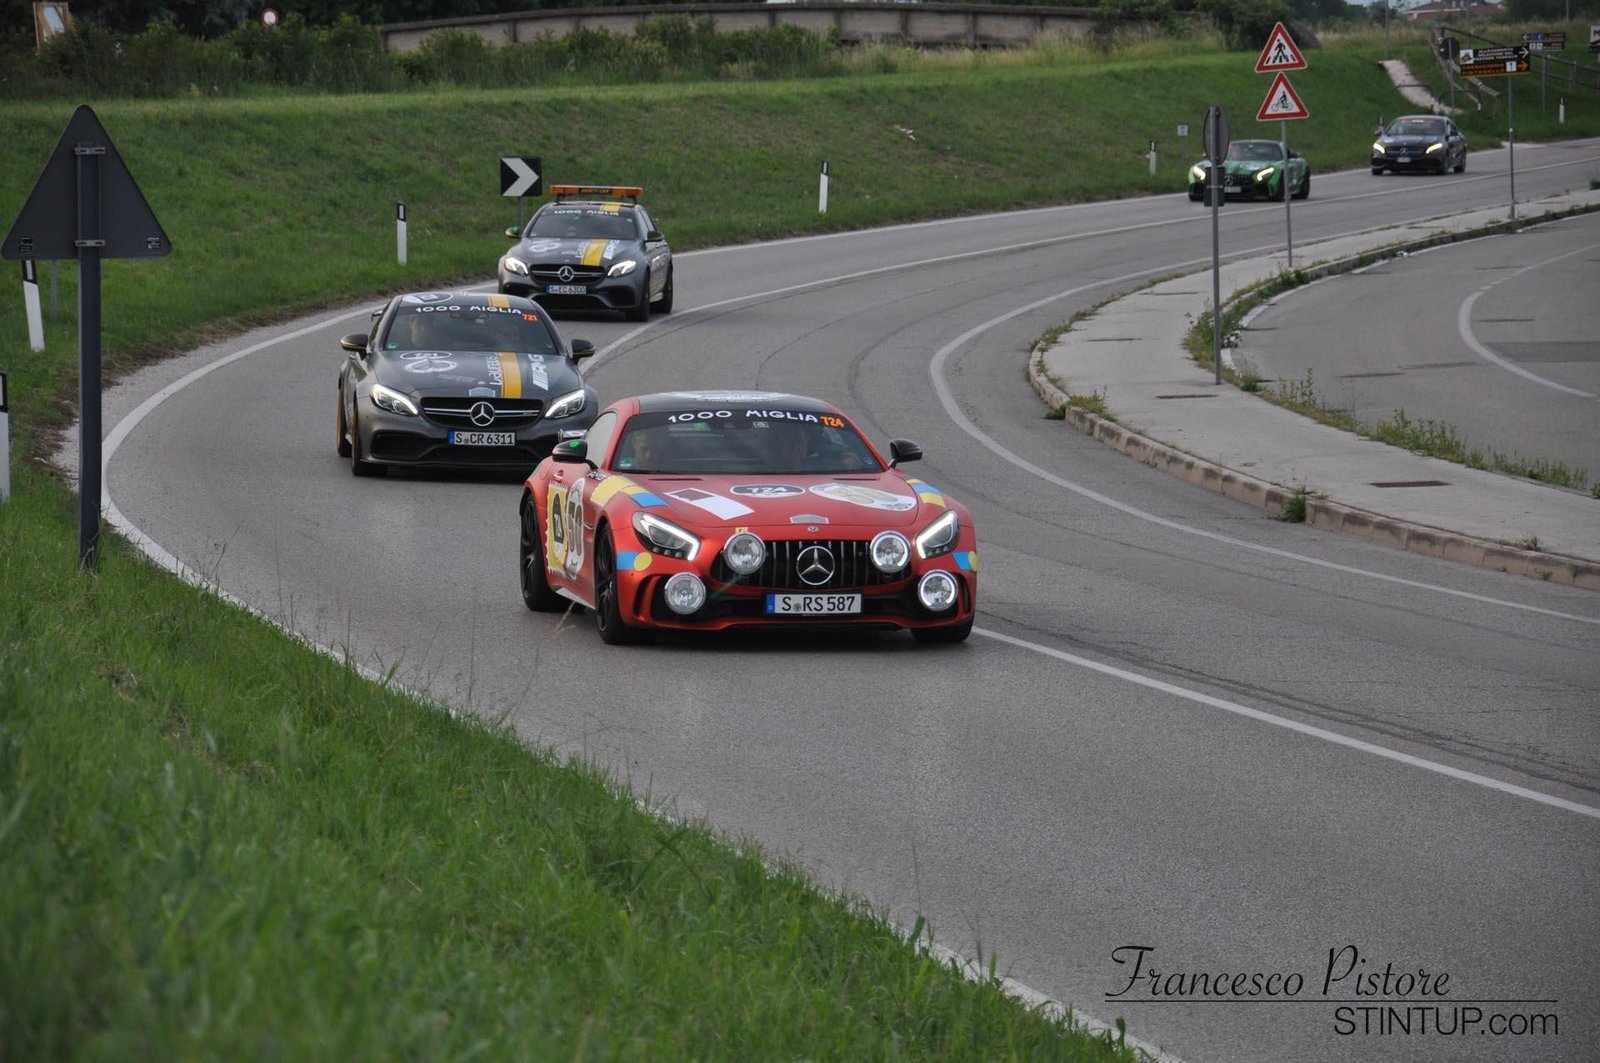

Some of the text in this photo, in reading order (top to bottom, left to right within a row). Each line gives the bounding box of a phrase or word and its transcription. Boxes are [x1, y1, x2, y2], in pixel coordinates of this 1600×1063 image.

[415, 305, 522, 314] 1000 MIGLIA
[667, 409, 819, 423] 1000 MIGLIA
[781, 596, 792, 612] S
